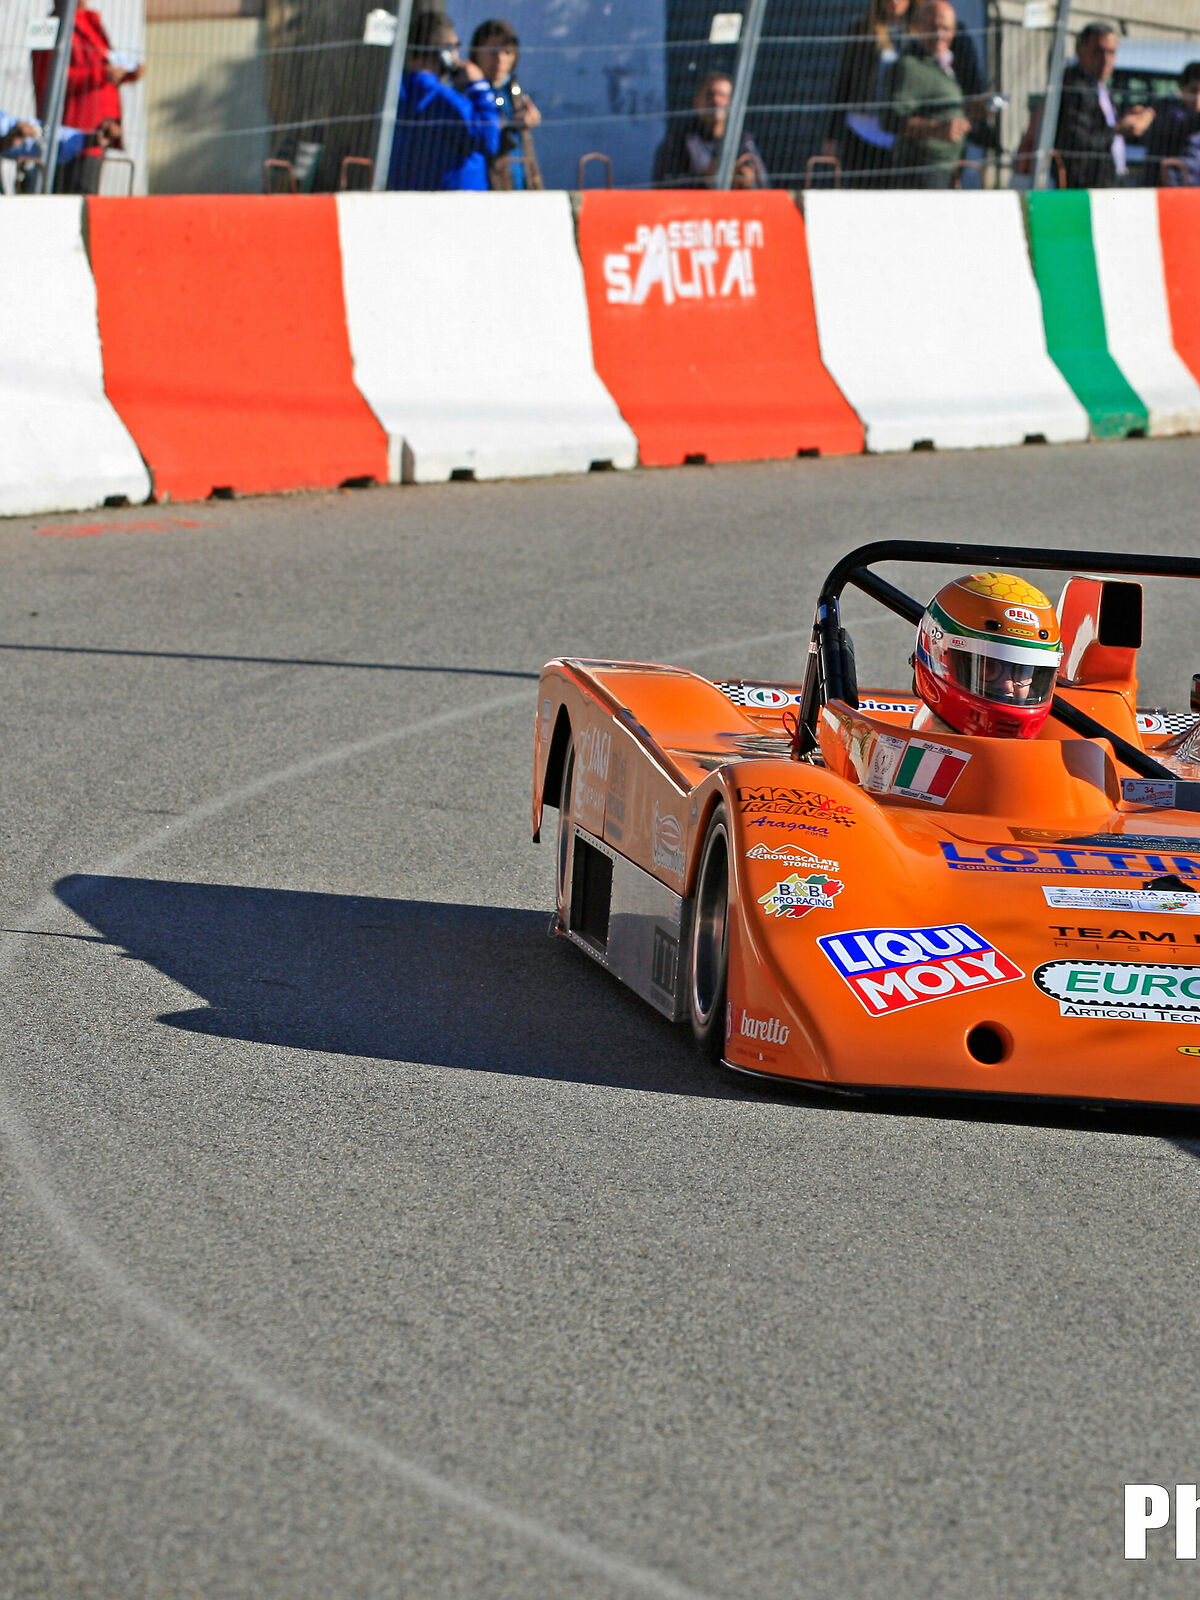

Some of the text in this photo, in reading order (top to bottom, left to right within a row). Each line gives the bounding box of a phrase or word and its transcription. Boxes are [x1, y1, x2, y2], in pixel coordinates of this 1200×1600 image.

[603, 236, 757, 305] SALITA!
[1009, 609, 1034, 621] BELL
[736, 787, 829, 808] MAXI
[740, 801, 834, 820] RACING
[746, 816, 829, 834] Aragona
[757, 853, 839, 867] CRONOSCALATE
[783, 861, 840, 872] STORICHE.IT
[1080, 888, 1158, 897] CAMUCIA
[773, 896, 833, 907] PRO-RACING
[1049, 926, 1176, 943] TEAM
[828, 927, 983, 973] LIQUI
[855, 951, 1006, 1010] MOLY
[1063, 1005, 1147, 1020] ARTICOLI
[741, 1008, 791, 1045] baretto
